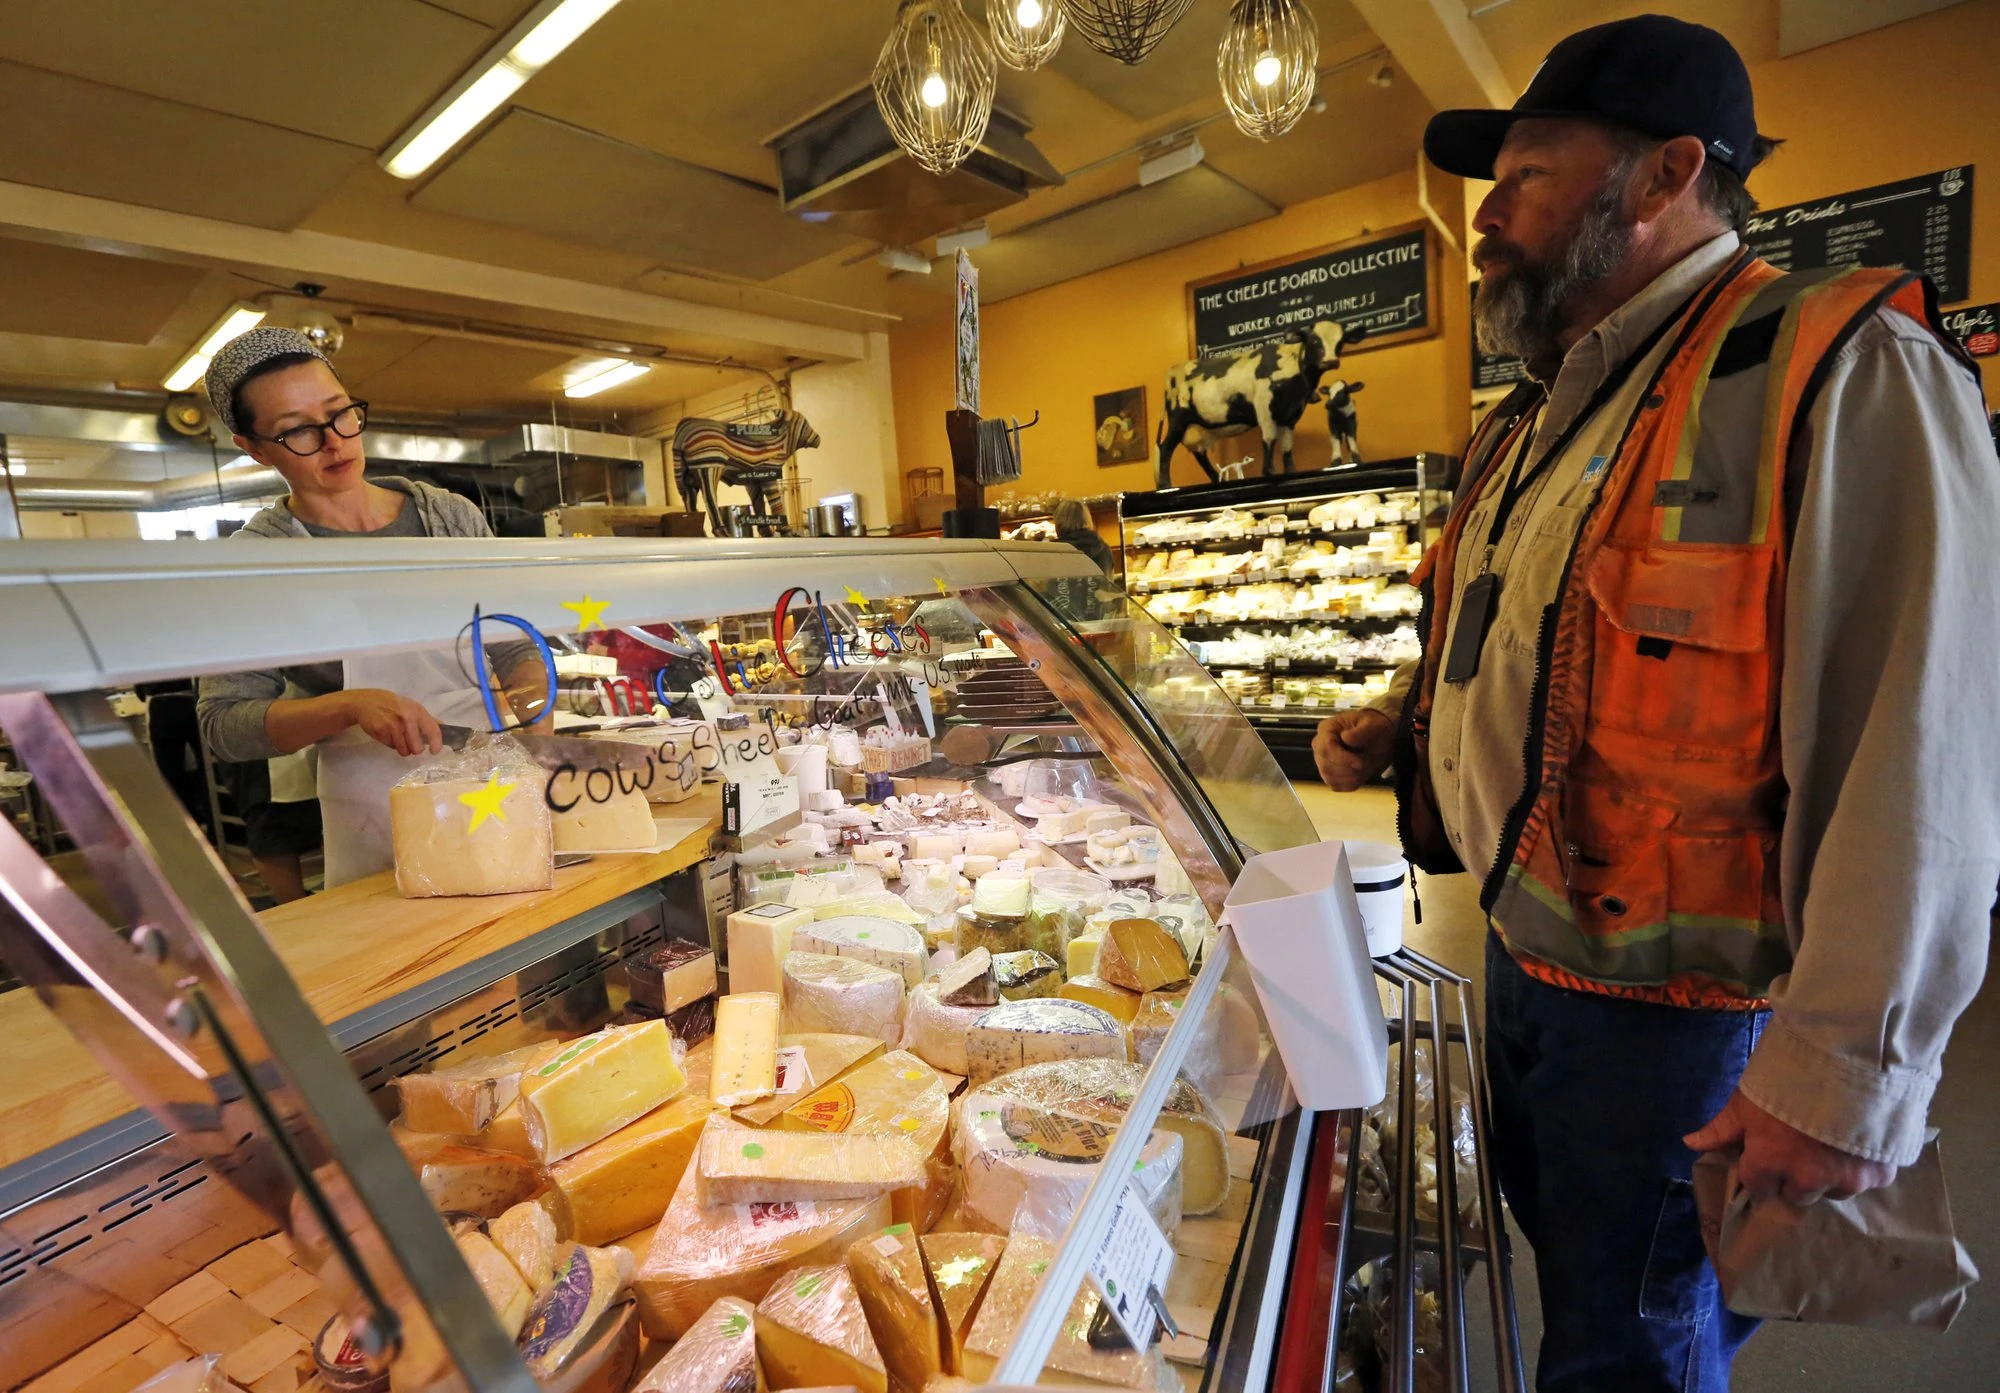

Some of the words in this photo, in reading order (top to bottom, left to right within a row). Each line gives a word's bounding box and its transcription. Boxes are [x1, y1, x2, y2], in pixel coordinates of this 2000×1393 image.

[1745, 217, 1779, 236] Hot
[1784, 200, 1846, 226] Drinks
[1199, 292, 1224, 312] THE
[1227, 280, 1278, 304] CHEESE
[1279, 267, 1328, 292] BOARD
[1329, 243, 1421, 279] COLLECTIVE
[1316, 291, 1377, 318] BUSINESS
[1952, 309, 1994, 336] Apple
[456, 602, 773, 734] Domestic
[774, 586, 931, 678] Cheeses
[692, 707, 801, 772] Sheep's
[1075, 1129, 1099, 1151] Blue
